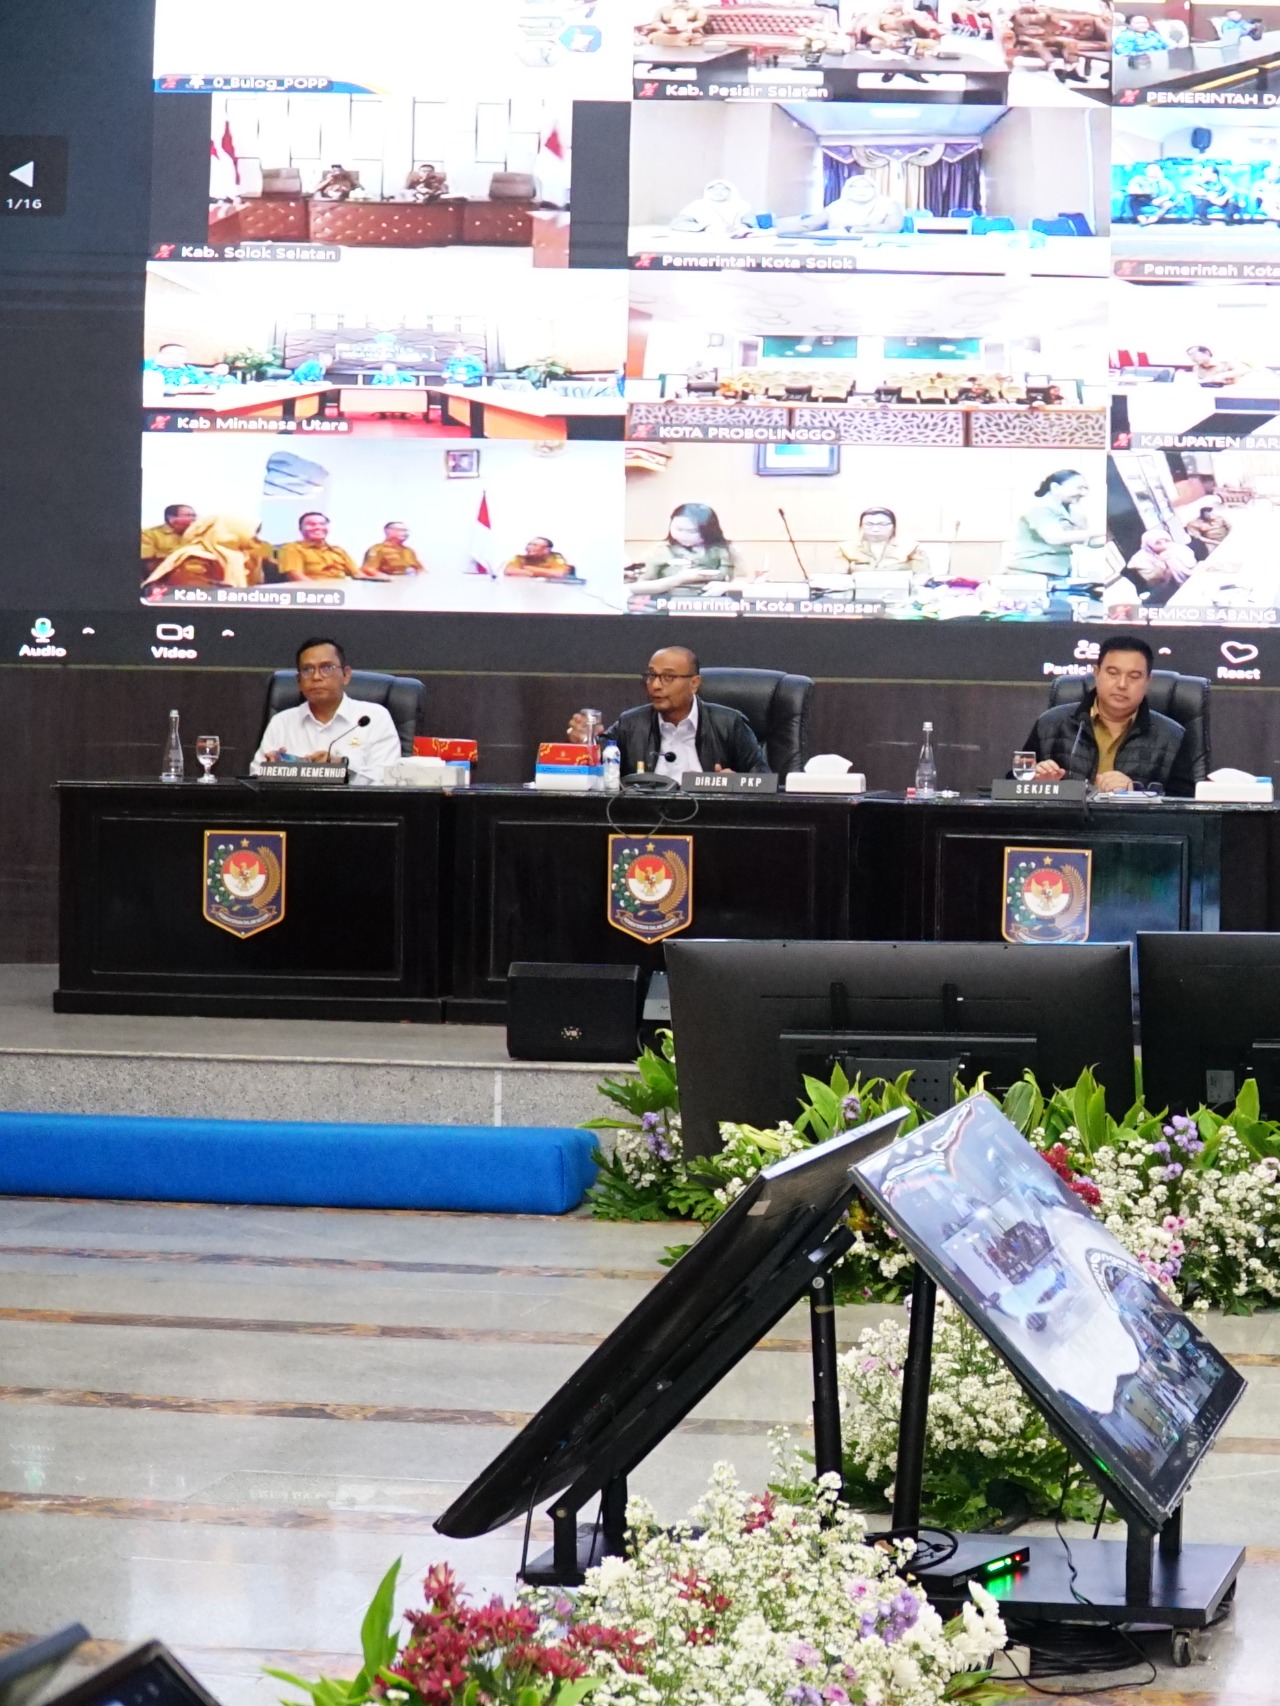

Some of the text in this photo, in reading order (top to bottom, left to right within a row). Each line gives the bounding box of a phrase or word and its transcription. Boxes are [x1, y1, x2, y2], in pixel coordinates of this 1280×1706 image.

[665, 84, 829, 98] Kab. Pesisir Selatan
[1146, 91, 1258, 105] PEMERINTAH
[6, 198, 43, 210] 1/16
[181, 246, 337, 260] Kab. Solok Selatan
[662, 255, 854, 270] Pemerintah Kota Solok
[1144, 264, 1239, 277] Pemerintah
[177, 417, 349, 432] Kab Minahasa Utara
[660, 426, 837, 441] KOTA PROBOLINGGO
[1140, 435, 1241, 449] KABUPATEN
[174, 588, 341, 605] Kab. Bandung Barat
[656, 598, 882, 616] Pemerintah Kota Denpasar
[1138, 607, 1278, 621] PEMKO SABANG
[18, 644, 68, 657] Audio
[151, 645, 198, 659] Video
[1217, 666, 1261, 679] React
[258, 766, 347, 778] DIREKTUR KEMENHUB
[695, 776, 762, 787] DIRJEN PKP
[1016, 784, 1060, 795] SEKJEN
